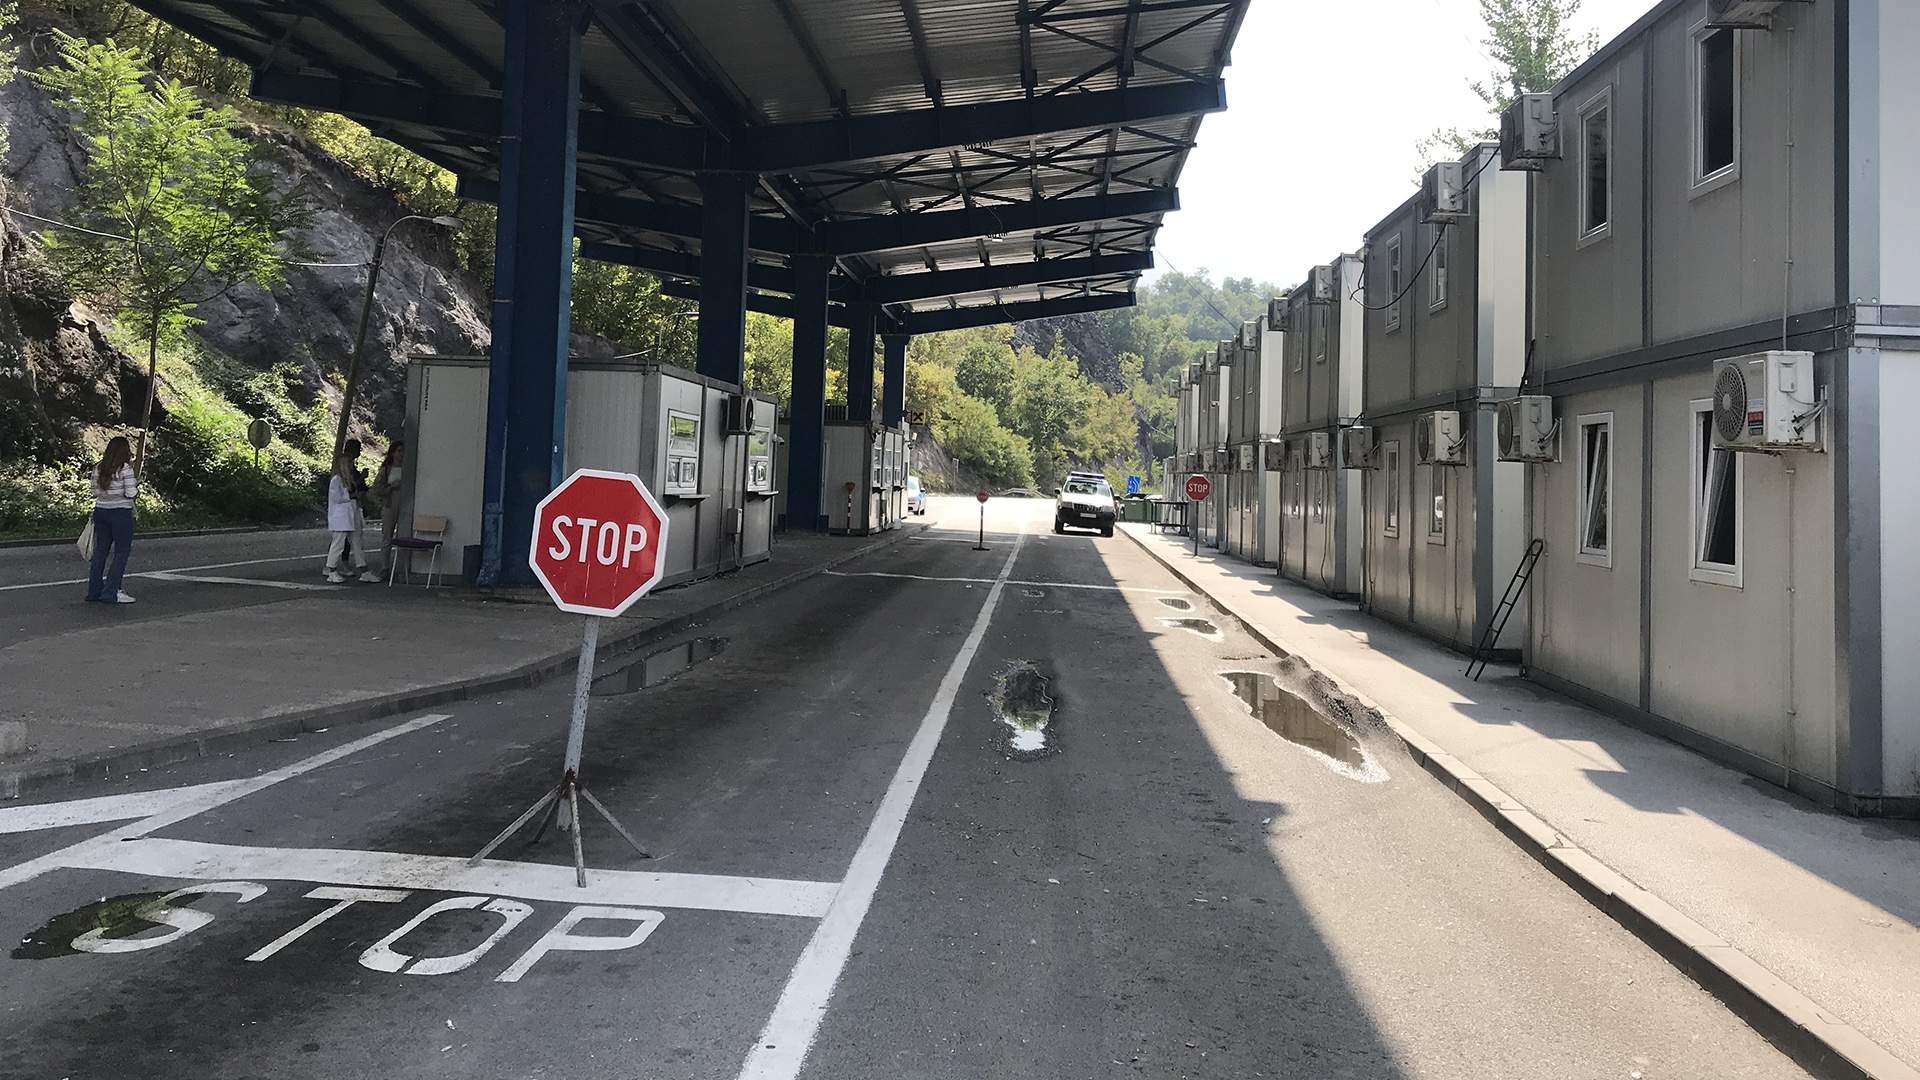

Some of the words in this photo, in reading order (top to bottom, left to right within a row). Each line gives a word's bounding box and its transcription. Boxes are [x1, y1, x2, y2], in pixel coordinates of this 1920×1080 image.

[1188, 483, 1208, 493] STOP
[548, 515, 648, 568] STOP
[70, 880, 666, 983] STOP
